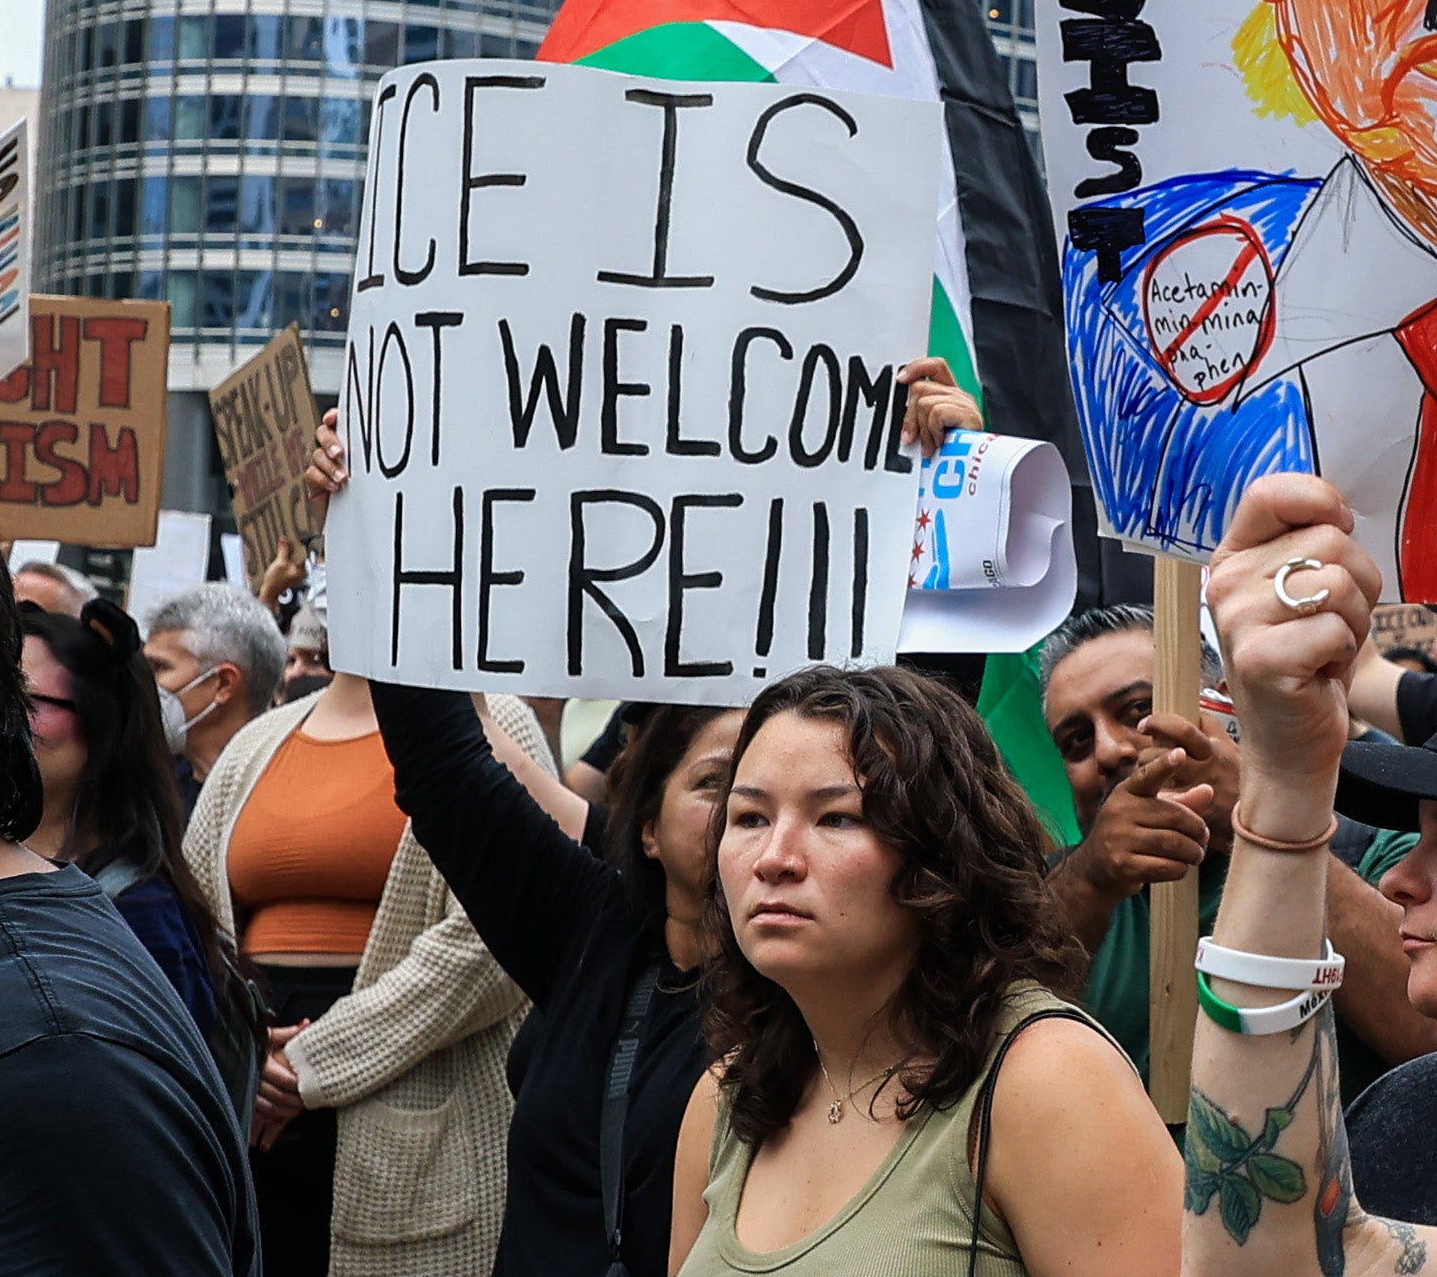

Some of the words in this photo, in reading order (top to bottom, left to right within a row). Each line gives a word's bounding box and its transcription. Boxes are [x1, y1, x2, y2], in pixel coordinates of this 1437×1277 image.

[358, 72, 546, 293] ICE
[597, 90, 864, 304] IS
[347, 312, 464, 480] NOT
